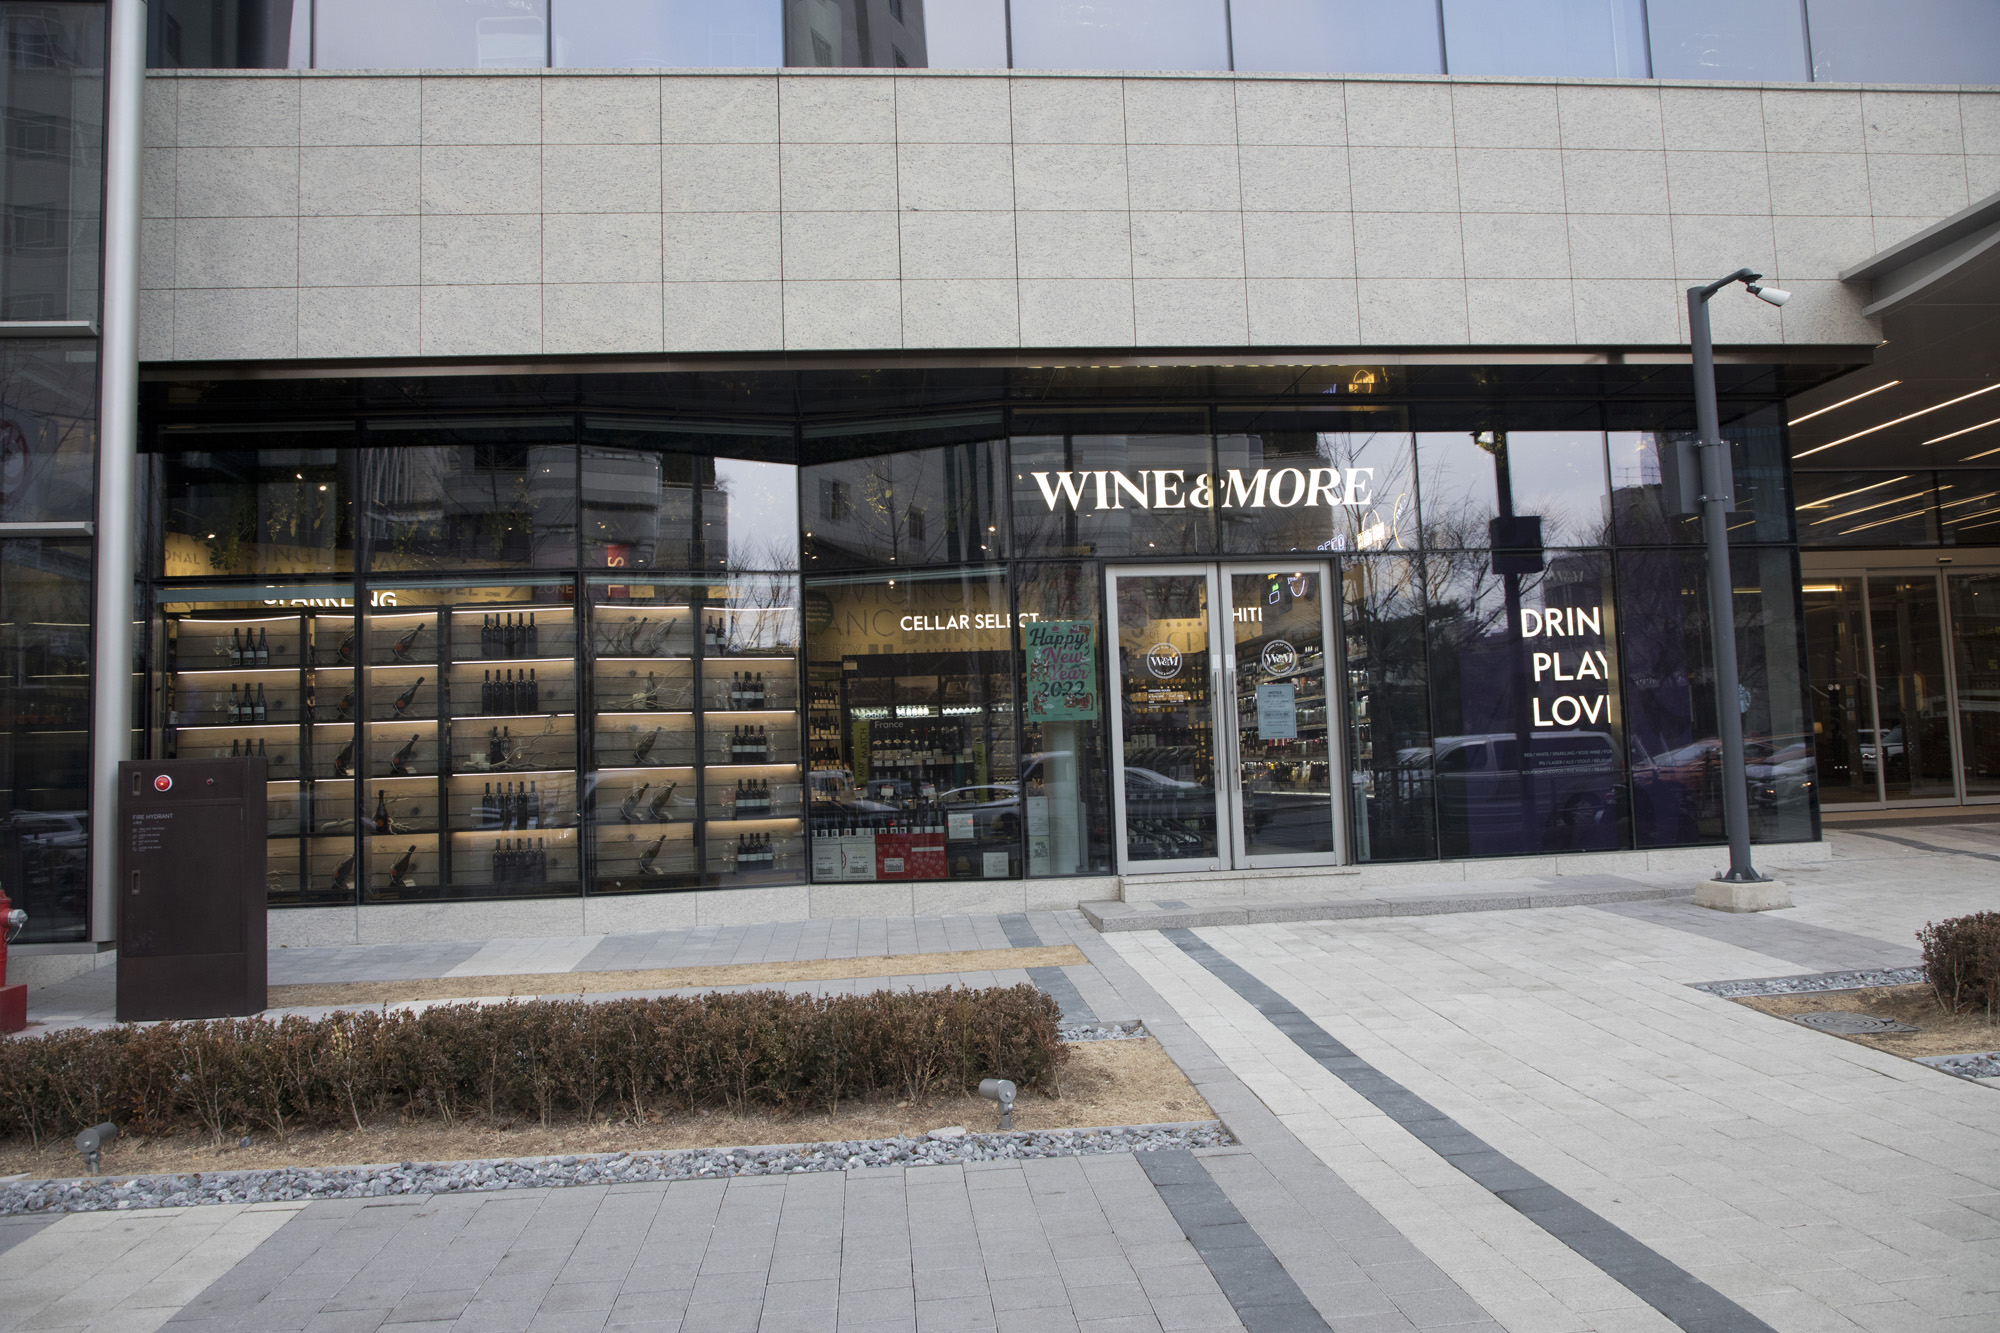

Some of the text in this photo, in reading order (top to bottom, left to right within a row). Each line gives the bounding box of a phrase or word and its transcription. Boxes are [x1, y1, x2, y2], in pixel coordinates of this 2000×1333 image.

[900, 614, 970, 632] CELLAR
[1232, 607, 1262, 622] HIT
[1029, 627, 1085, 651] Happy
[1042, 646, 1086, 664] New
[1150, 655, 1179, 667] W&M
[1265, 652, 1293, 664] W&M
[1049, 662, 1091, 681] Year
[1533, 650, 1608, 682] PLAY
[1039, 680, 1085, 698] 2022
[1532, 694, 1611, 727] LOV
[859, 728, 868, 758] MATCH
